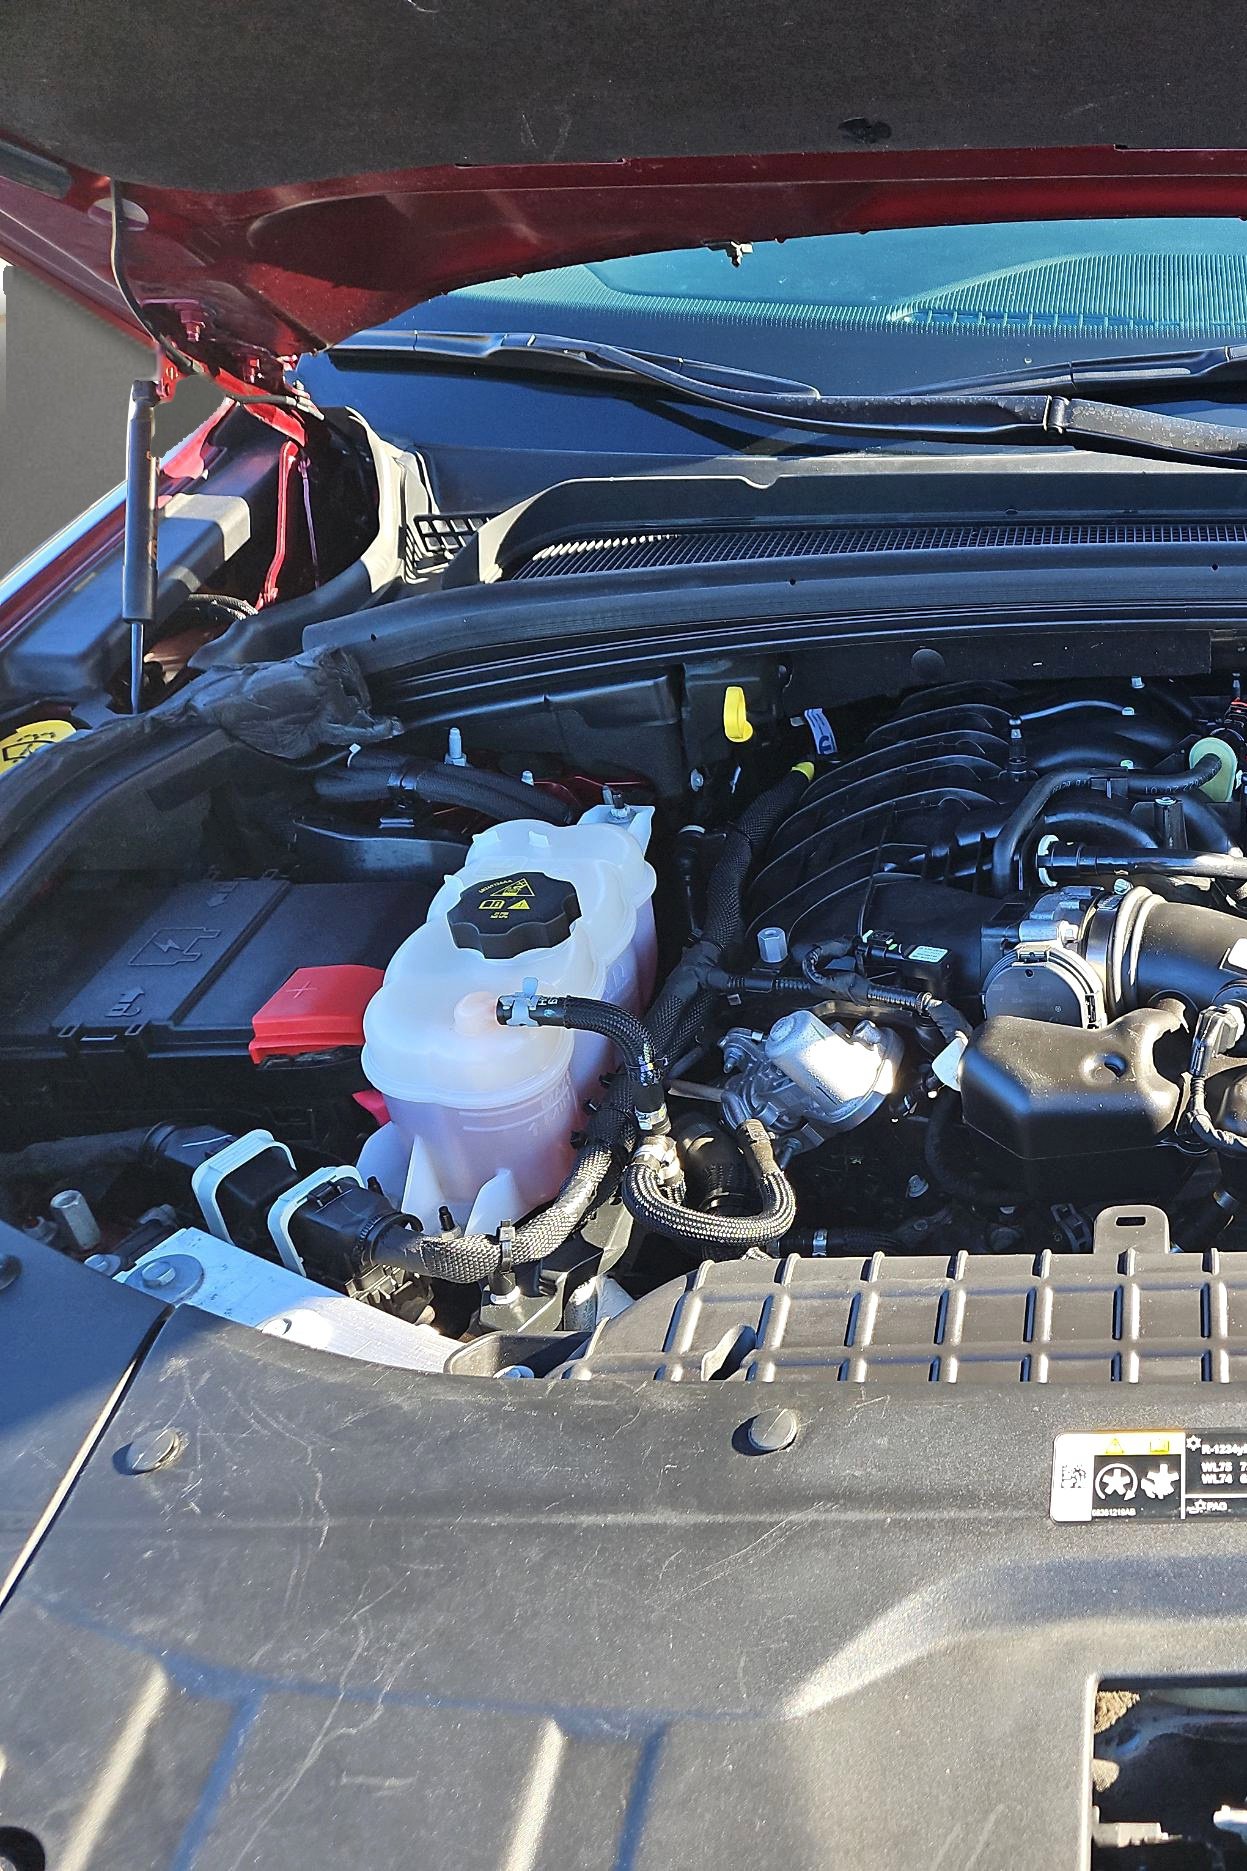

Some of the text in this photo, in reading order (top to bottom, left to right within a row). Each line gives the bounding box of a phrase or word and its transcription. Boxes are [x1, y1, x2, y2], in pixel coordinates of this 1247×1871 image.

[1201, 1461, 1232, 1472] WL75
[1201, 1473, 1233, 1484] WL74
[1207, 1502, 1227, 1511] PAG
